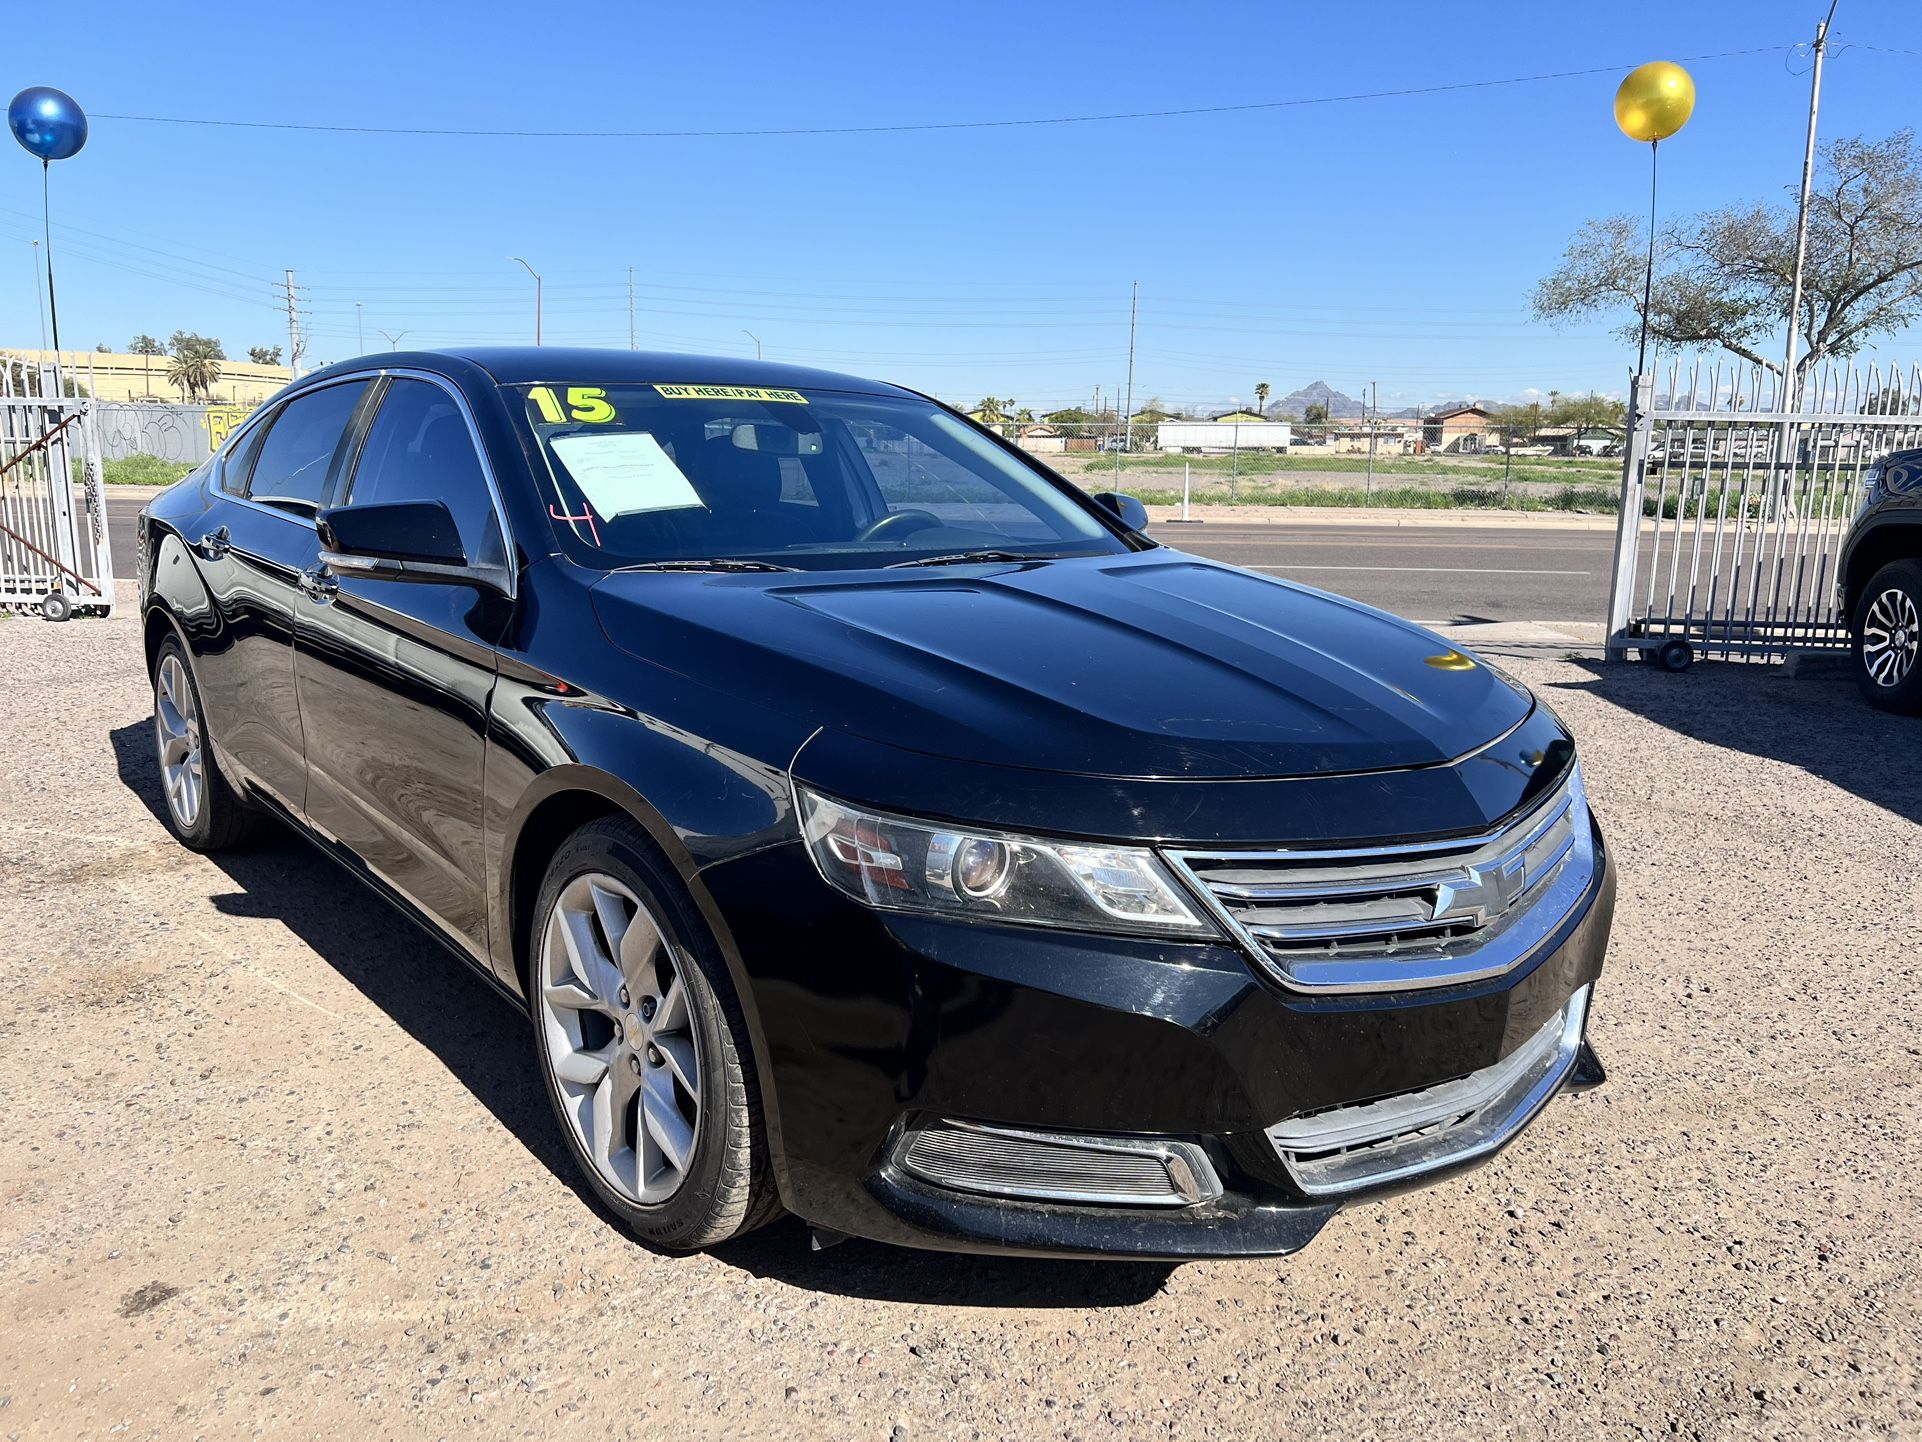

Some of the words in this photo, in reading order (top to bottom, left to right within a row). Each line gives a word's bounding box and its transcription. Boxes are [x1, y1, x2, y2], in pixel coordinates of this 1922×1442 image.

[527, 386, 616, 423] 15
[659, 386, 691, 396] BUY
[764, 390, 803, 401] HERE
[549, 502, 601, 547] 4
